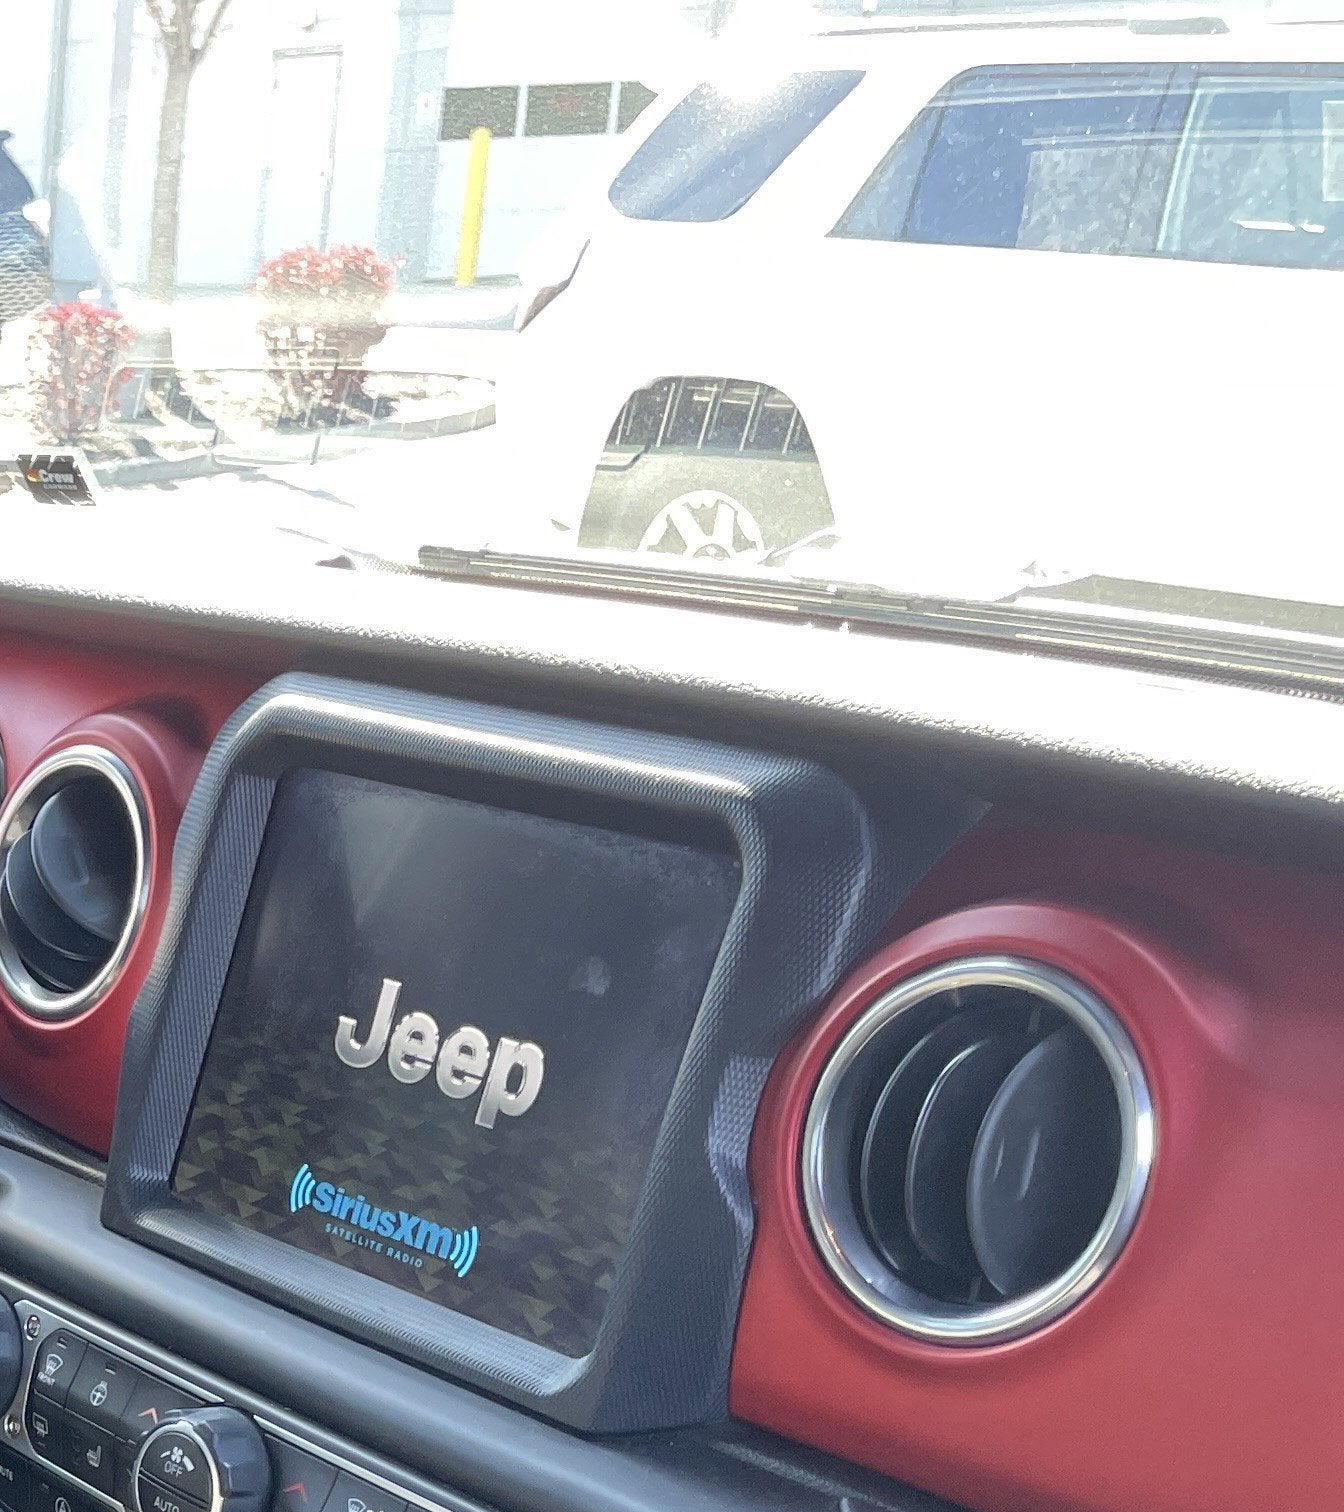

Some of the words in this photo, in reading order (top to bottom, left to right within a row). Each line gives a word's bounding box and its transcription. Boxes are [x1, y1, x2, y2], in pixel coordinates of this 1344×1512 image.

[334, 977, 545, 1130] Jeep
[324, 1222, 384, 1254] SATELLITE
[386, 1246, 424, 1269] RADIO
[164, 1461, 184, 1478] OFF
